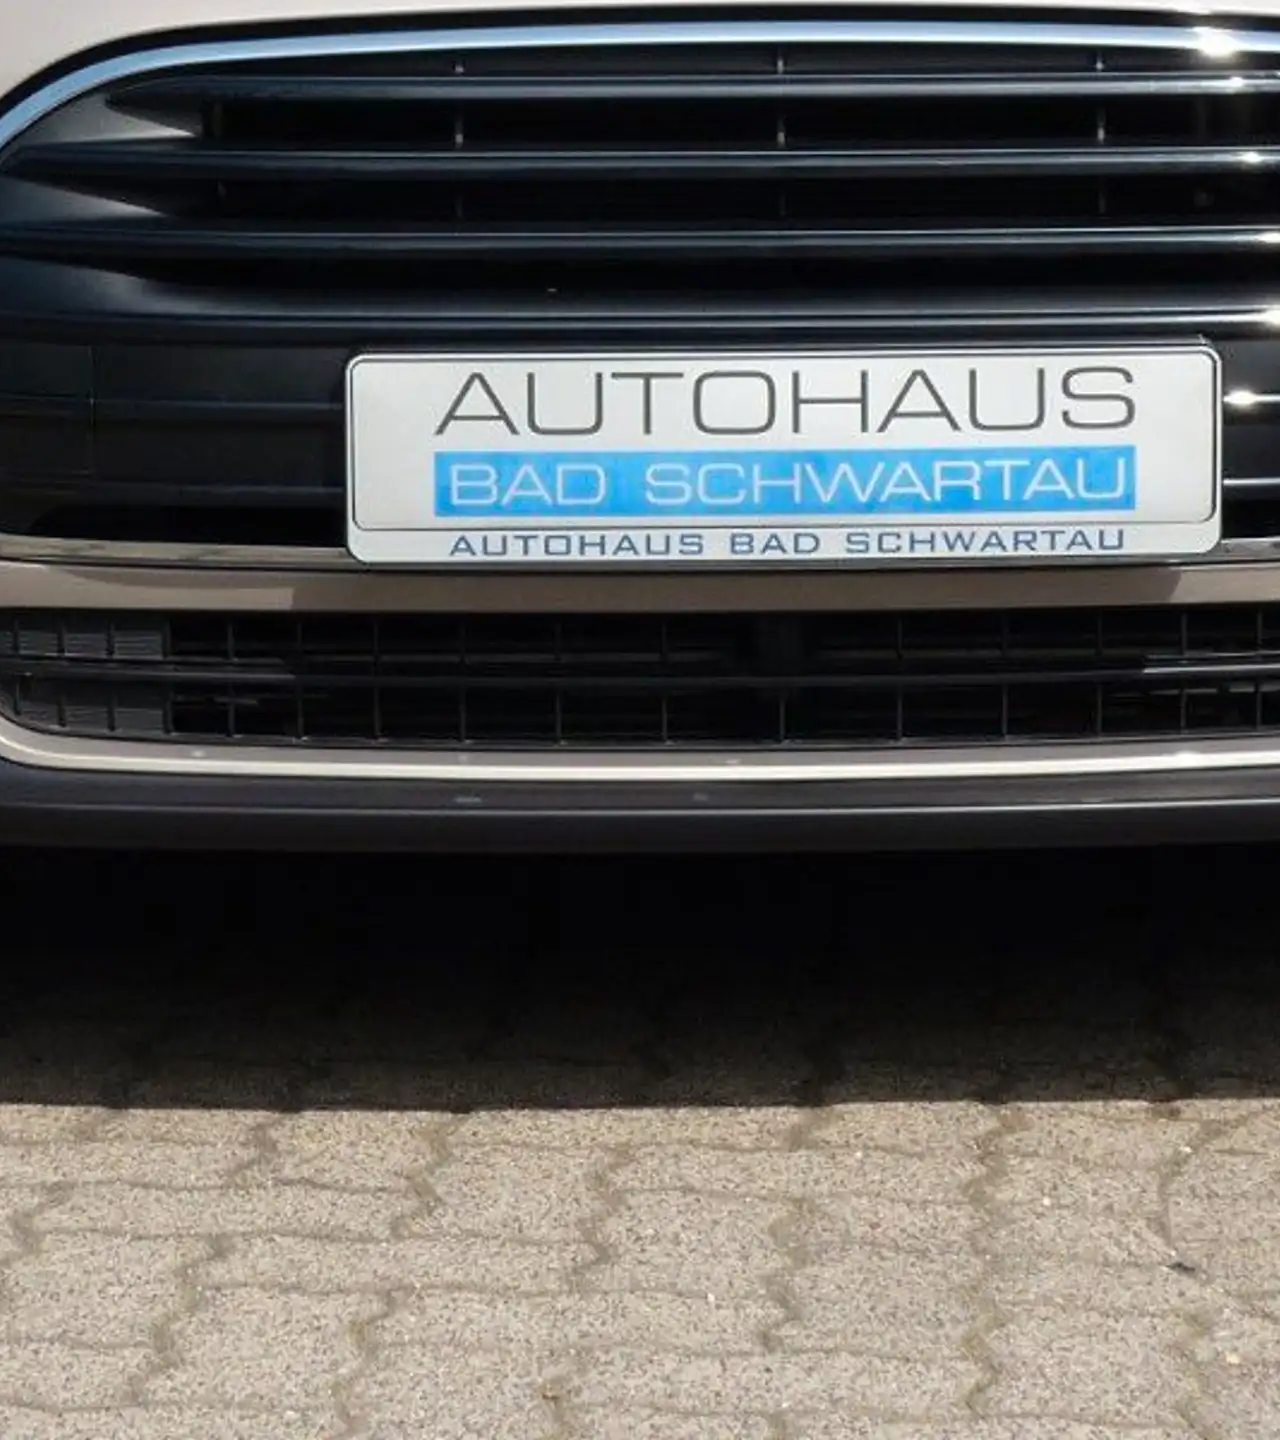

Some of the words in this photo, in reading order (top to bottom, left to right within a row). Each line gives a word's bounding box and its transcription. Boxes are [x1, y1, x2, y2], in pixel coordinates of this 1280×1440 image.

[434, 366, 1136, 436] AUTOHAUS
[449, 462, 607, 506] BAD
[644, 457, 1126, 506] SCHWARTAU
[449, 533, 705, 557] AUTOHAUS
[728, 532, 821, 556] BAD
[845, 528, 1125, 554] SCHWARTAU
